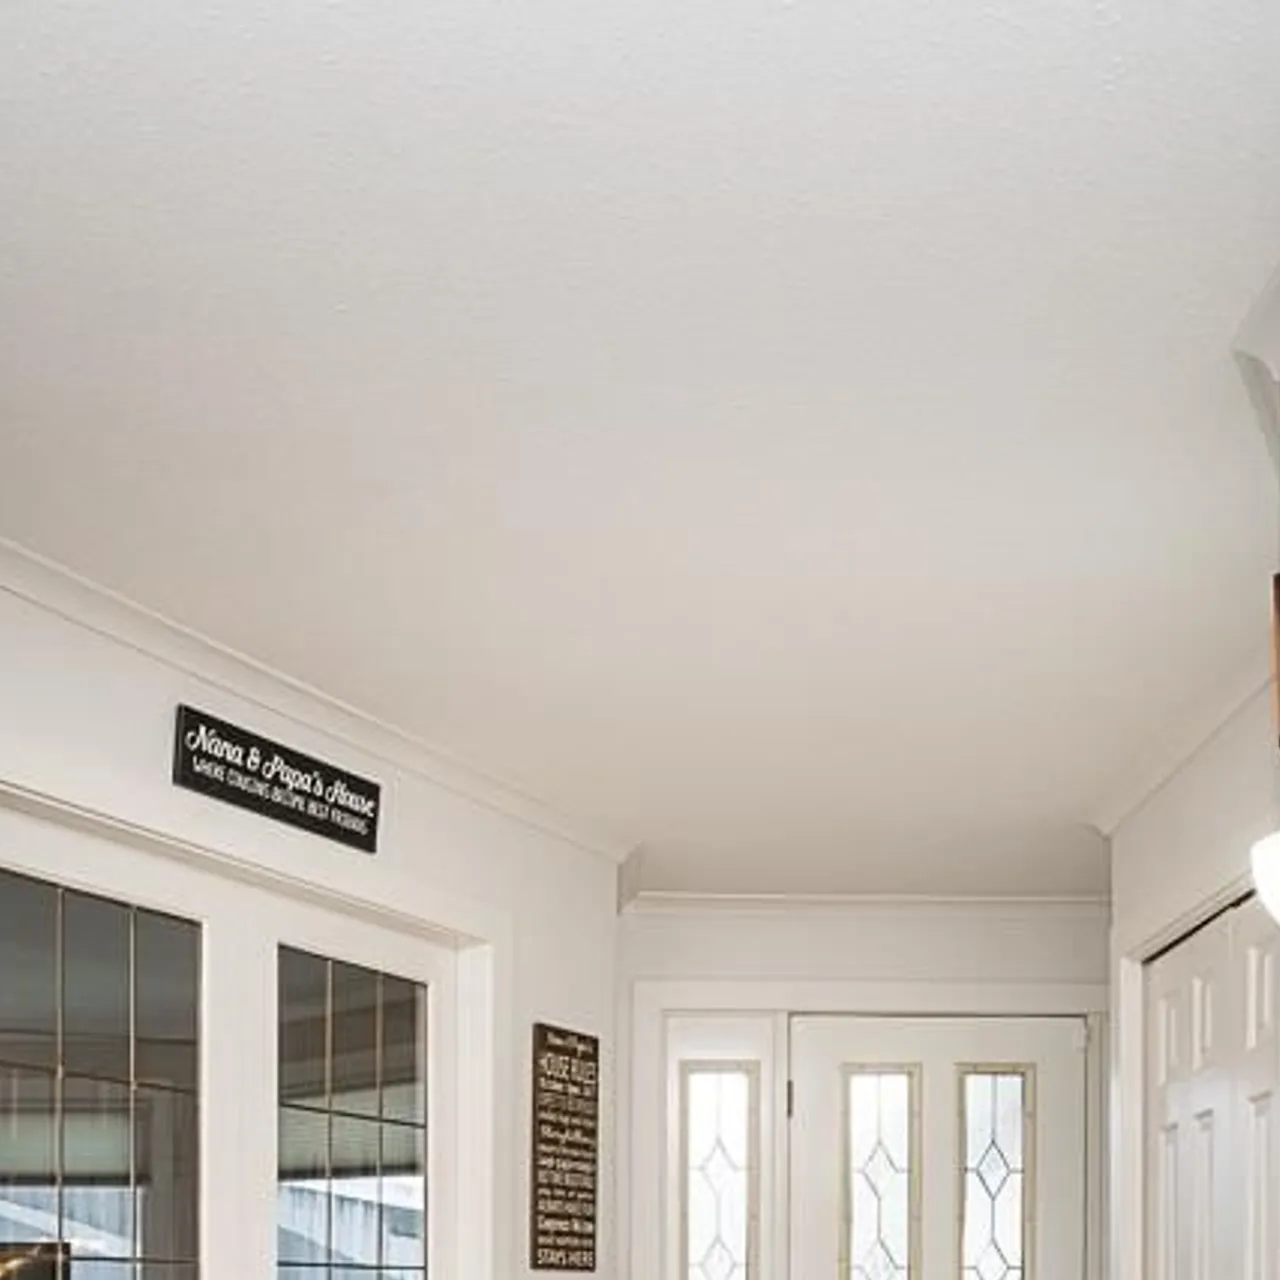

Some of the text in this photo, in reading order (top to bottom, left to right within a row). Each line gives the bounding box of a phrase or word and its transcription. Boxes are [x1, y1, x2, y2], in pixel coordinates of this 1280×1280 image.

[184, 723, 375, 818] Nana & Papa's House
